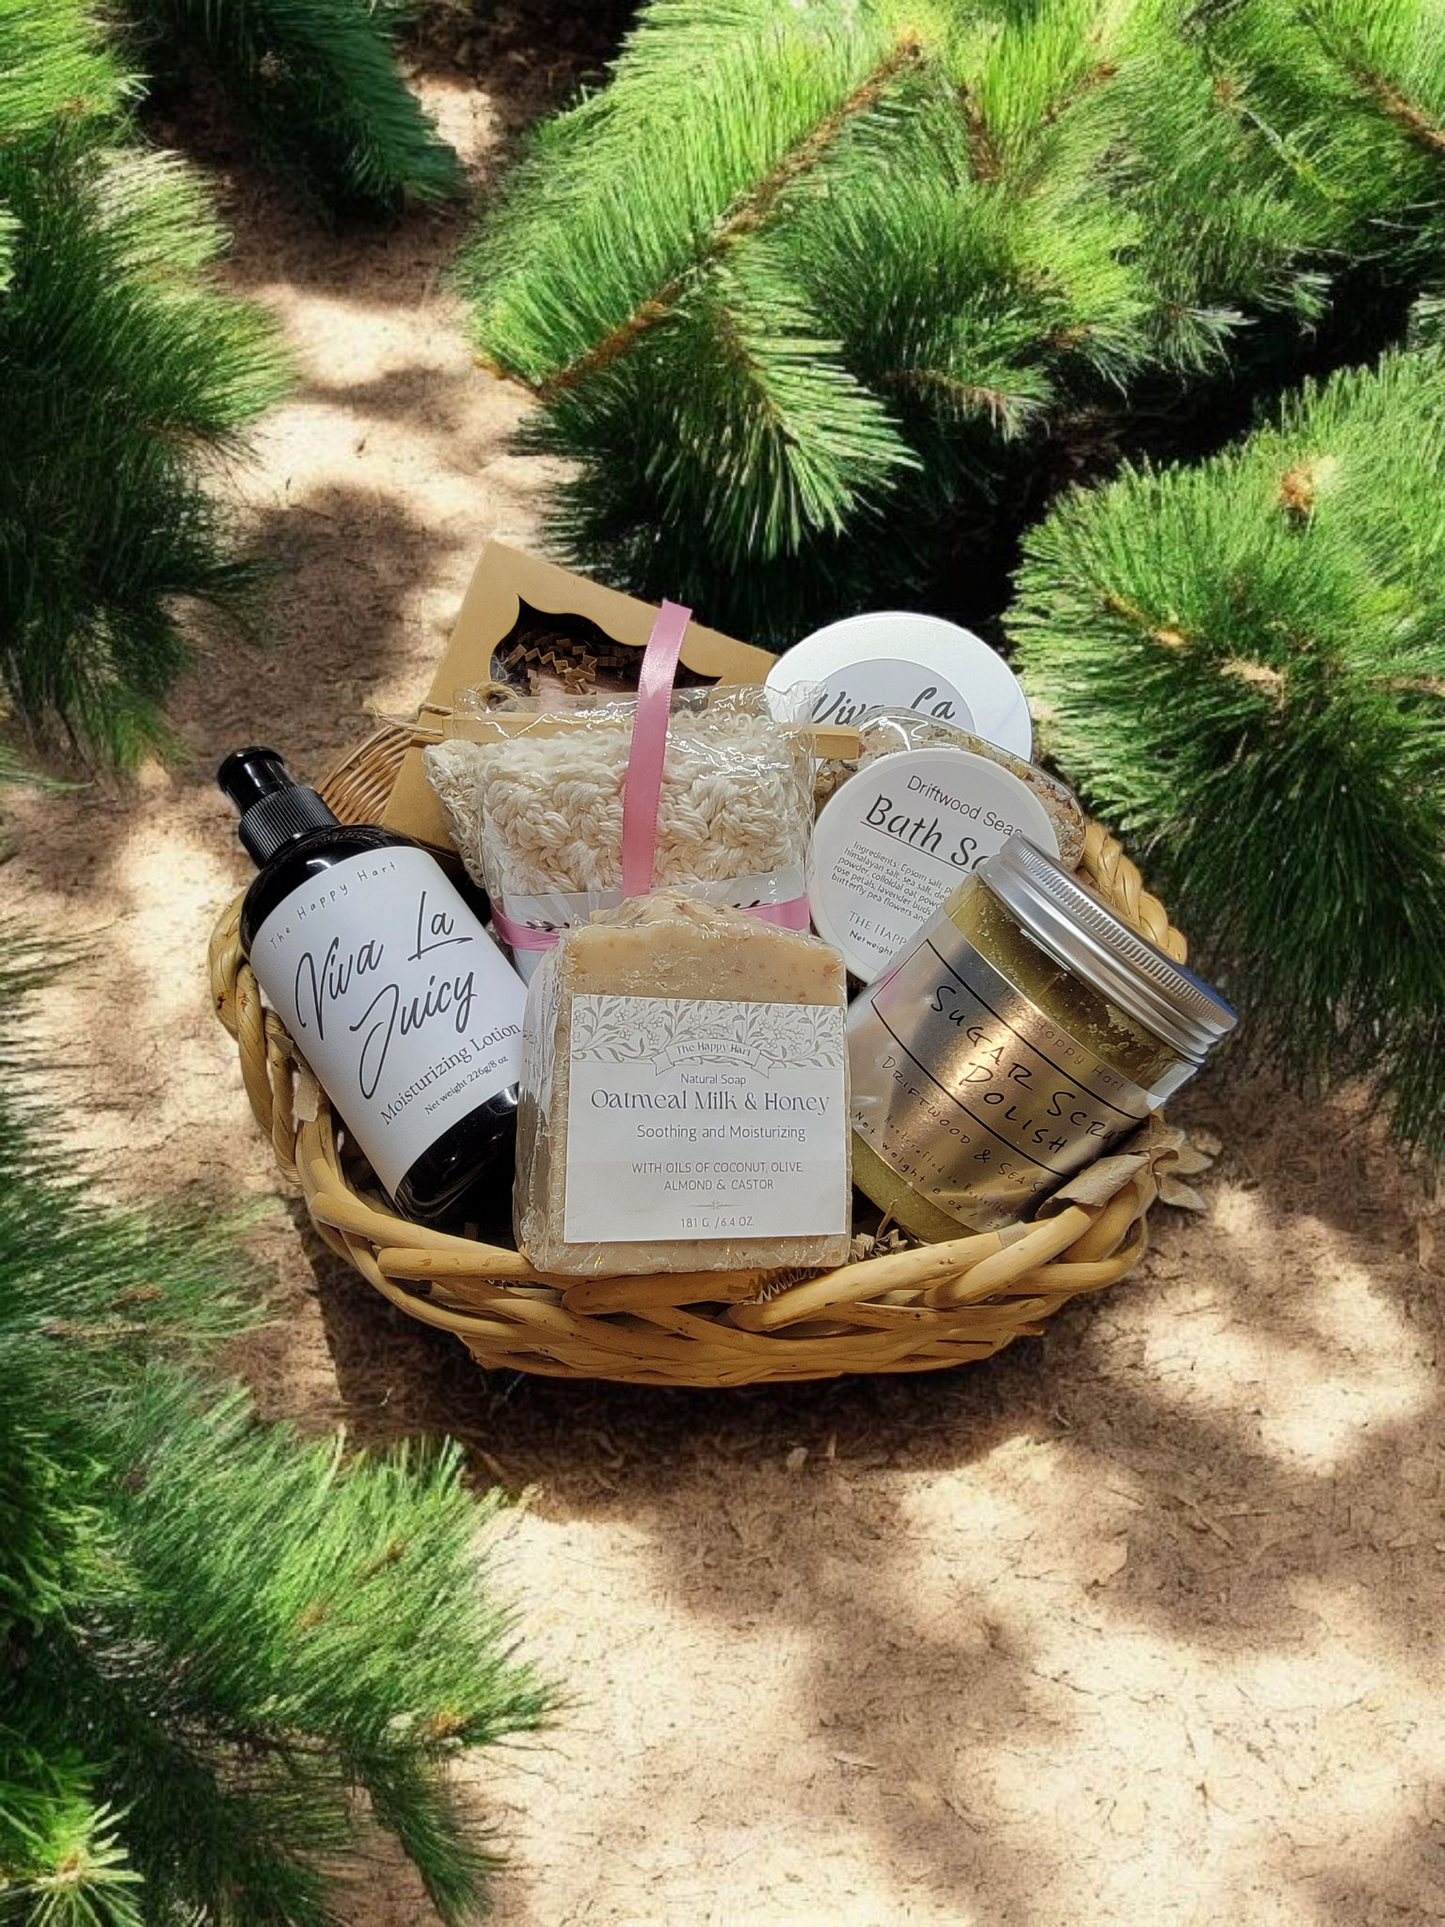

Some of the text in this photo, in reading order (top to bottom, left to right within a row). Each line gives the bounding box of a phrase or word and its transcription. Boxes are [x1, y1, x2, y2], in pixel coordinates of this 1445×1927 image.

[906, 774, 983, 821] Driftwood
[865, 793, 943, 852] Bath
[838, 857, 870, 877] powder,
[871, 872, 904, 891] colloidal
[903, 886, 918, 899] oat
[844, 847, 884, 872] himalayan
[902, 875, 916, 887] sea
[853, 841, 898, 868] Ingredients:
[900, 863, 927, 882] Epsom
[269, 861, 397, 950] The Happy Hart
[831, 873, 867, 896] butterfly
[866, 891, 882, 903] pea
[883, 897, 912, 917] flowers
[833, 865, 932, 916] rose petals, lavender buds
[848, 911, 873, 930] THE
[849, 930, 866, 943] Net
[865, 939, 893, 956] weight
[294, 890, 473, 1042] Viva La
[349, 970, 479, 1101] Juicy
[677, 1042, 751, 1057] The Happy Hart
[1034, 1017, 1086, 1066] Happy
[1092, 1064, 1126, 1092] Hart
[380, 1023, 522, 1126] Moisturizing Lotion
[424, 1056, 509, 1115] Net weight 226g/8 oz
[680, 1073, 747, 1087] Natural Soap
[591, 1089, 830, 1115] Oatmeal Milk & Honey
[882, 1055, 1026, 1185] DRIFTWOOD & SEA
[958, 1061, 1068, 1154] POLISH
[637, 1124, 807, 1142] Soothing and Moisturizing
[632, 1162, 662, 1174] WITH
[665, 1162, 692, 1173] OILS
[695, 1162, 710, 1173] OF
[713, 1161, 768, 1174] COCONUT,
[854, 1111, 876, 1135] Net
[882, 1142, 926, 1182] weight
[948, 1200, 963, 1212] oz
[663, 1178, 775, 1191] ALMOND & CASTOR
[680, 1218, 698, 1228] 181
